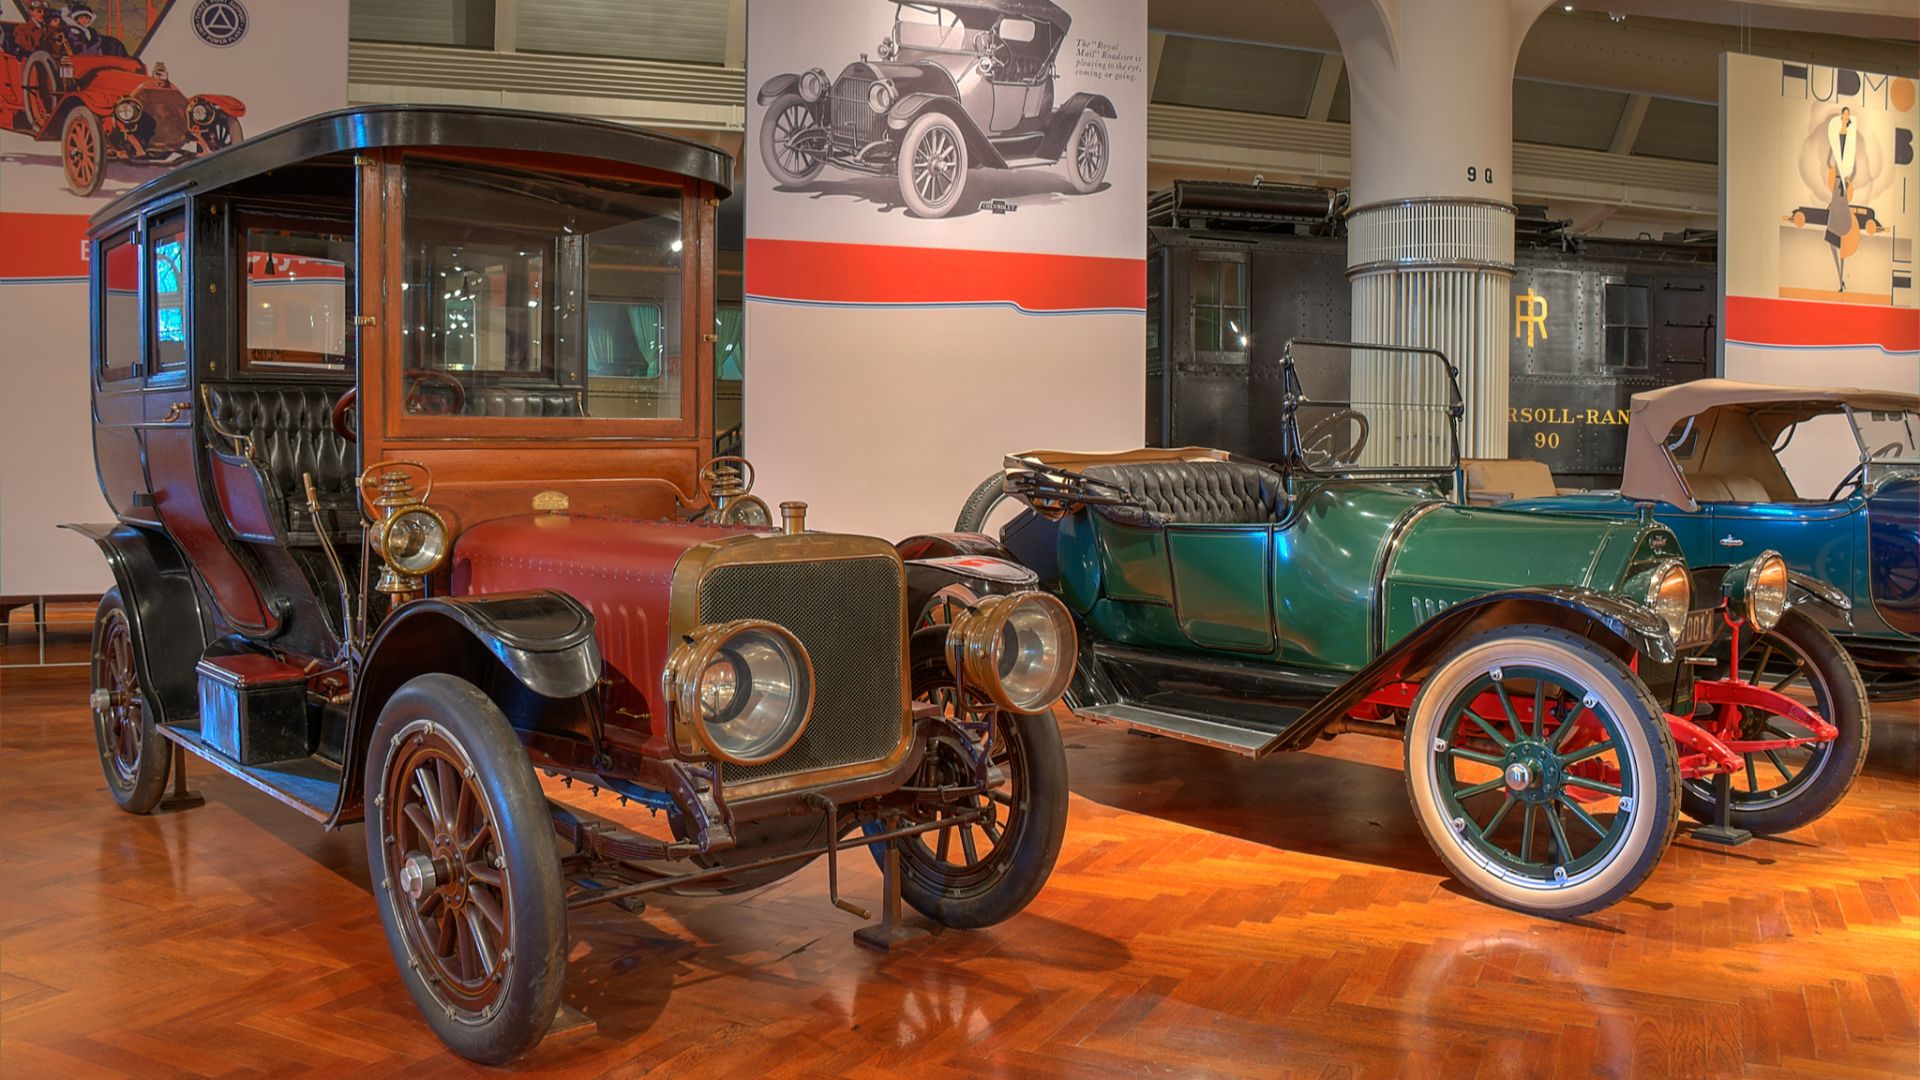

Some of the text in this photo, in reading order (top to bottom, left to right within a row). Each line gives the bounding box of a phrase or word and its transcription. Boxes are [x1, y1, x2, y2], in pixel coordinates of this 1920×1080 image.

[1076, 39, 1090, 48] The
[1101, 51, 1133, 61] Roadster
[1075, 58, 1106, 70] pleasing
[1116, 62, 1126, 70] the
[1127, 65, 1142, 73] eye,
[1075, 69, 1102, 80] coming
[1114, 72, 1137, 82] going.
[981, 201, 1017, 212] CHEVROLET
[1508, 407, 1631, 425] RSOLL-RAN
[1534, 432, 1560, 448] 90
